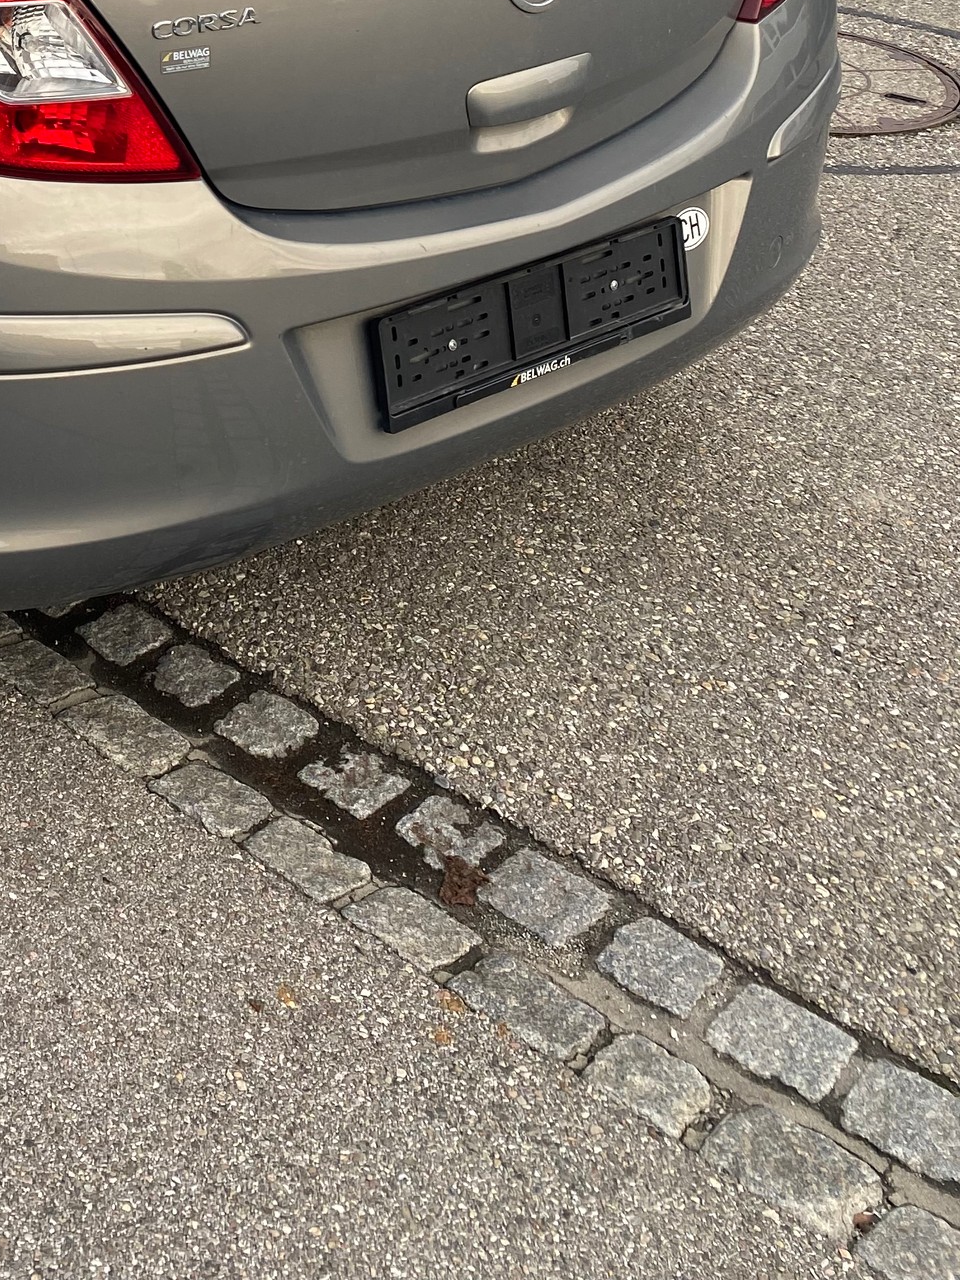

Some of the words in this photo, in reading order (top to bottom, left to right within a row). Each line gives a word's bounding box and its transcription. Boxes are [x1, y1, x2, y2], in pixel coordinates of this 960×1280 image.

[151, 6, 261, 40] CORSA
[173, 47, 210, 61] BELWAG
[520, 355, 571, 384] BELWAG.ch
